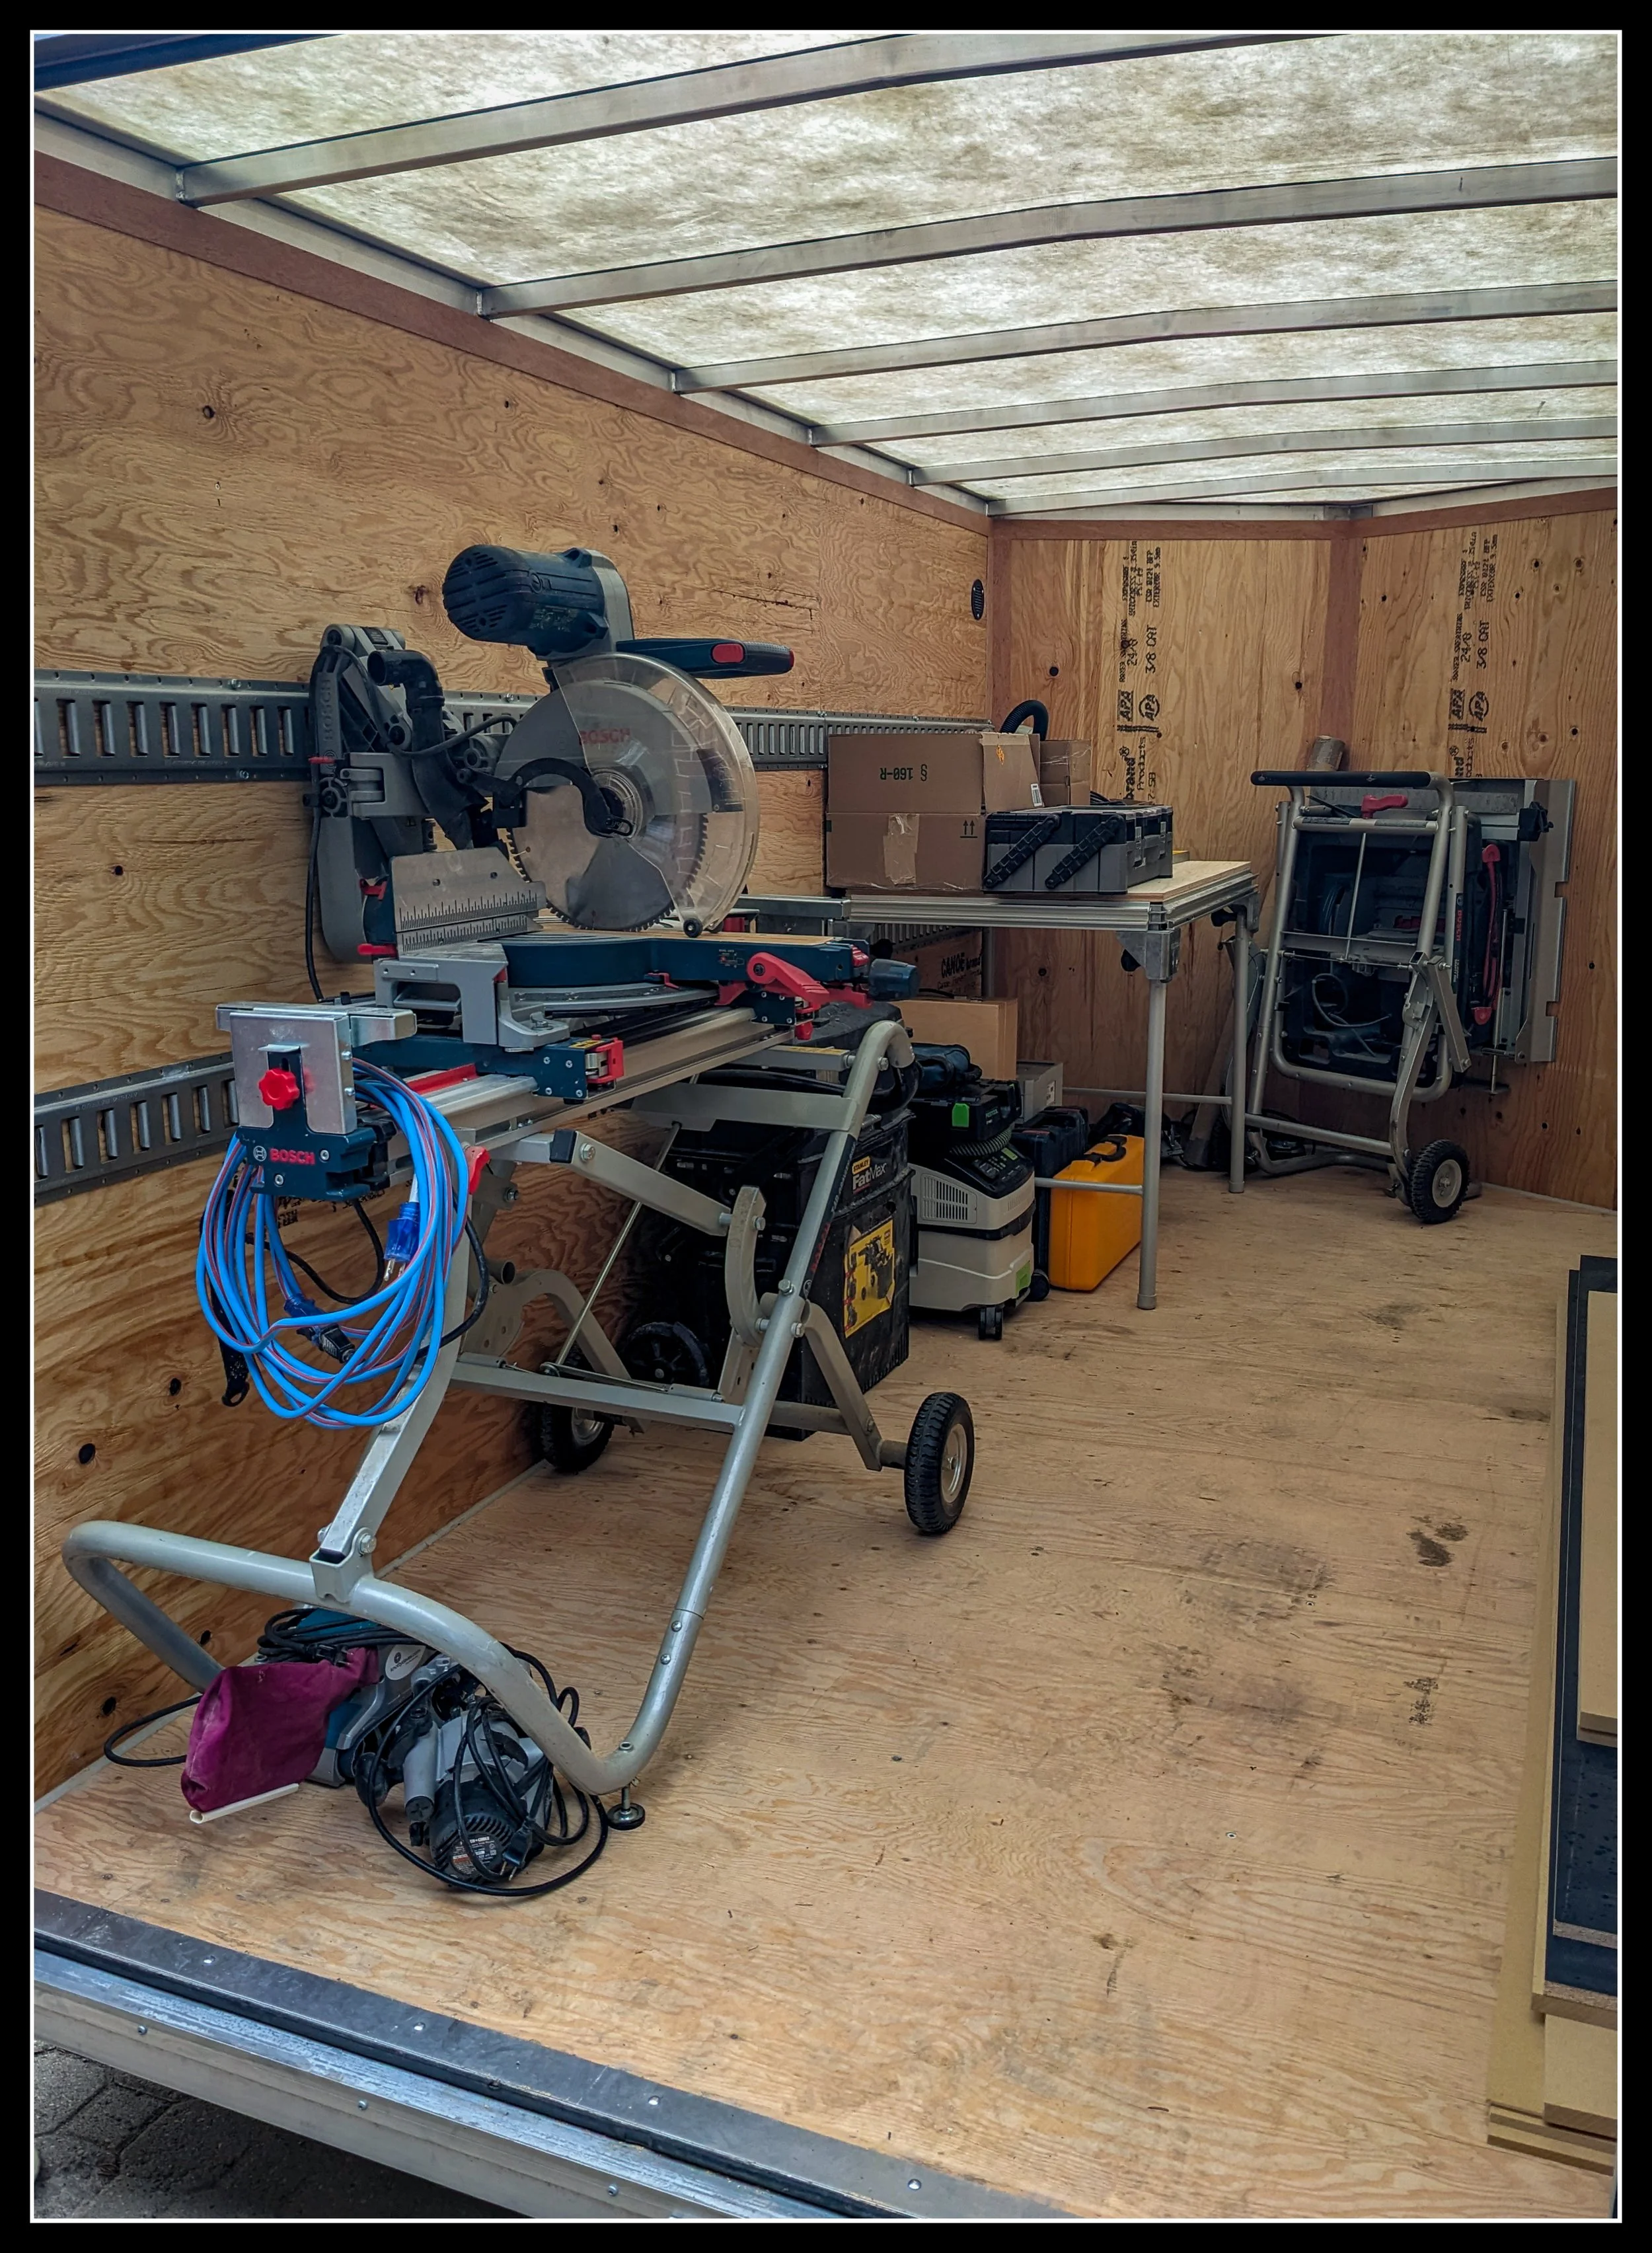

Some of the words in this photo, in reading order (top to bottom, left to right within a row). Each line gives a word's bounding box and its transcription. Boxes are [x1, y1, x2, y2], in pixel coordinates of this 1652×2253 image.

[1146, 624, 1157, 647] CAT
[1478, 620, 1490, 642] CAT
[1145, 651, 1156, 674] 3/8
[1476, 646, 1487, 669] 3/8
[1121, 690, 1132, 722] APA
[1144, 693, 1156, 721] APA
[1452, 689, 1463, 720] APA
[1474, 691, 1485, 722] APA
[580, 728, 631, 744] BOSCH
[880, 767, 914, 781] 160-R
[1137, 736, 1146, 791] Products
[269, 1147, 316, 1165] BOSCH
[853, 1159, 869, 1172] STANLEY
[852, 1163, 887, 1190] FatMax
